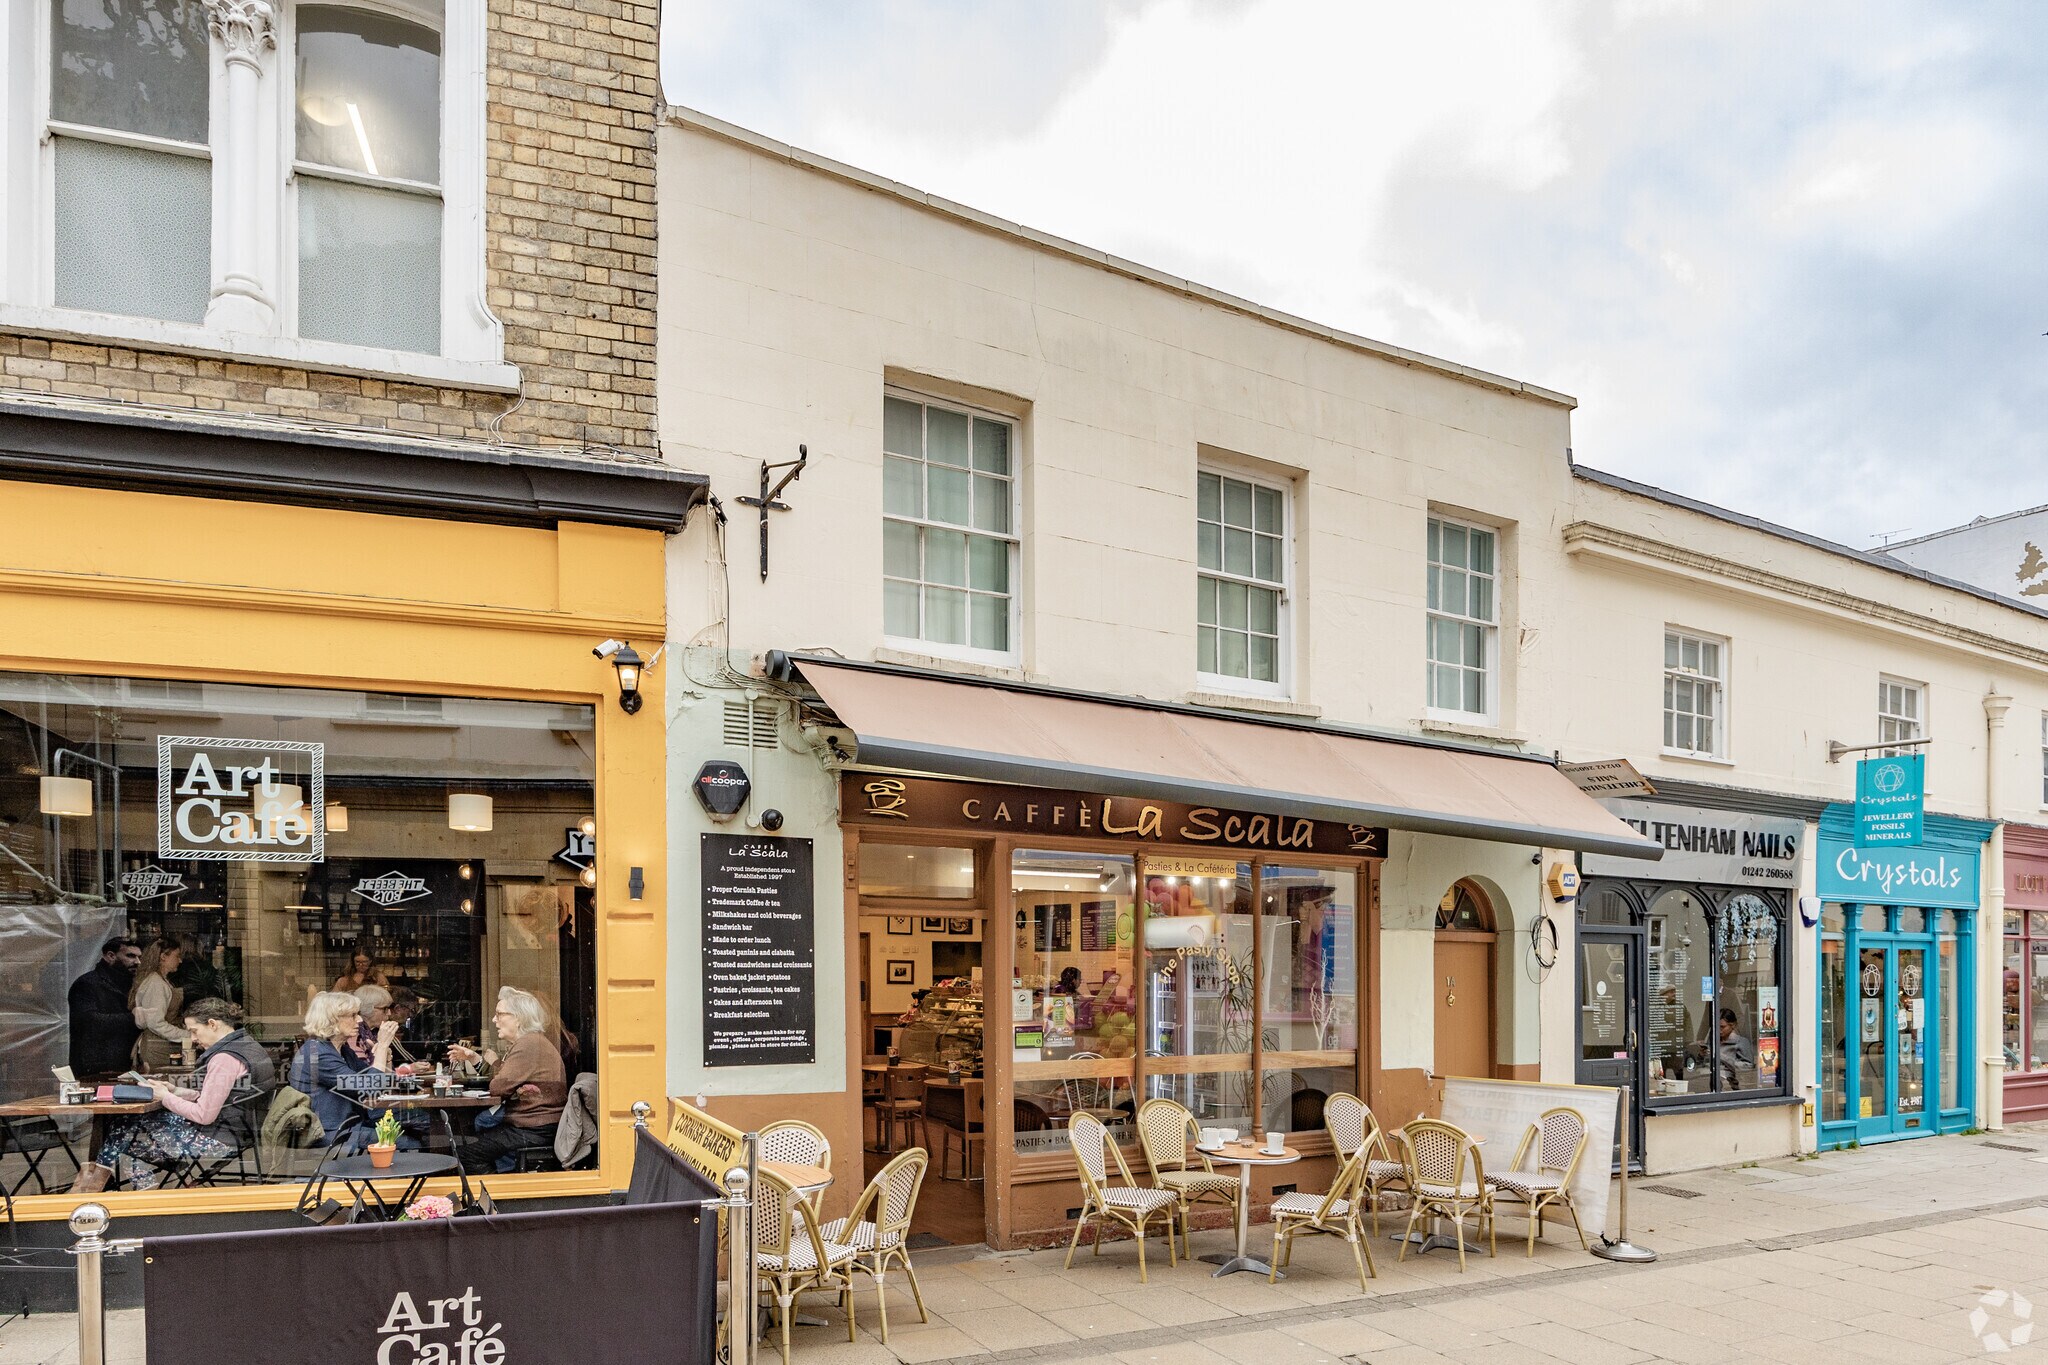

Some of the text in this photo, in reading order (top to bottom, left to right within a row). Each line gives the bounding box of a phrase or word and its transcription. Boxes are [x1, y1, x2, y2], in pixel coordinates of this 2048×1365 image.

[175, 752, 281, 799] Art
[700, 775, 748, 786] allcooper
[1586, 774, 1619, 783] NAILS
[1860, 793, 1918, 806] Crystals
[175, 797, 307, 846] Café
[1862, 811, 1915, 822] JEWELLERY
[961, 798, 1314, 848] CAFFÈ La Scala
[1871, 822, 1905, 831] FOSSILS
[1864, 832, 1912, 841] MINERALS
[1742, 830, 1796, 861] NAILS
[728, 847, 789, 858] La Scala
[726, 865, 744, 873] proud
[744, 866, 780, 874] independent
[1143, 860, 1173, 871] Pasties
[1174, 862, 1182, 871] &
[1184, 862, 1194, 872] La
[1836, 847, 1962, 895] Crystals
[733, 872, 767, 880] Established
[1741, 866, 1793, 880] 01242 260588
[711, 886, 778, 895] Proper Cornish Pasties
[711, 898, 746, 906] Trademark
[745, 899, 765, 907] Coffee
[764, 899, 771, 907] &
[711, 911, 748, 919] Milkshakes
[747, 911, 760, 919] and
[772, 912, 802, 921] beverages
[711, 923, 742, 931] Sandwich
[754, 936, 772, 944] lunch
[712, 948, 736, 956] Toasted
[736, 949, 759, 957] paninis
[759, 948, 771, 956] and
[736, 961, 771, 969] sandwiches
[1157, 944, 1240, 985] The Pasty Shop
[728, 973, 748, 981] baked
[747, 974, 766, 982] jacket
[766, 974, 791, 982] potatoes
[731, 998, 744, 1006] and
[743, 998, 773, 1006] afternoon
[713, 1010, 770, 1019] Breakfast selection
[675, 1112, 736, 1163] CORNISH BAKERS
[1015, 1137, 1046, 1147] PASTIES
[376, 1286, 483, 1334] Art
[376, 1322, 506, 1365] Café
